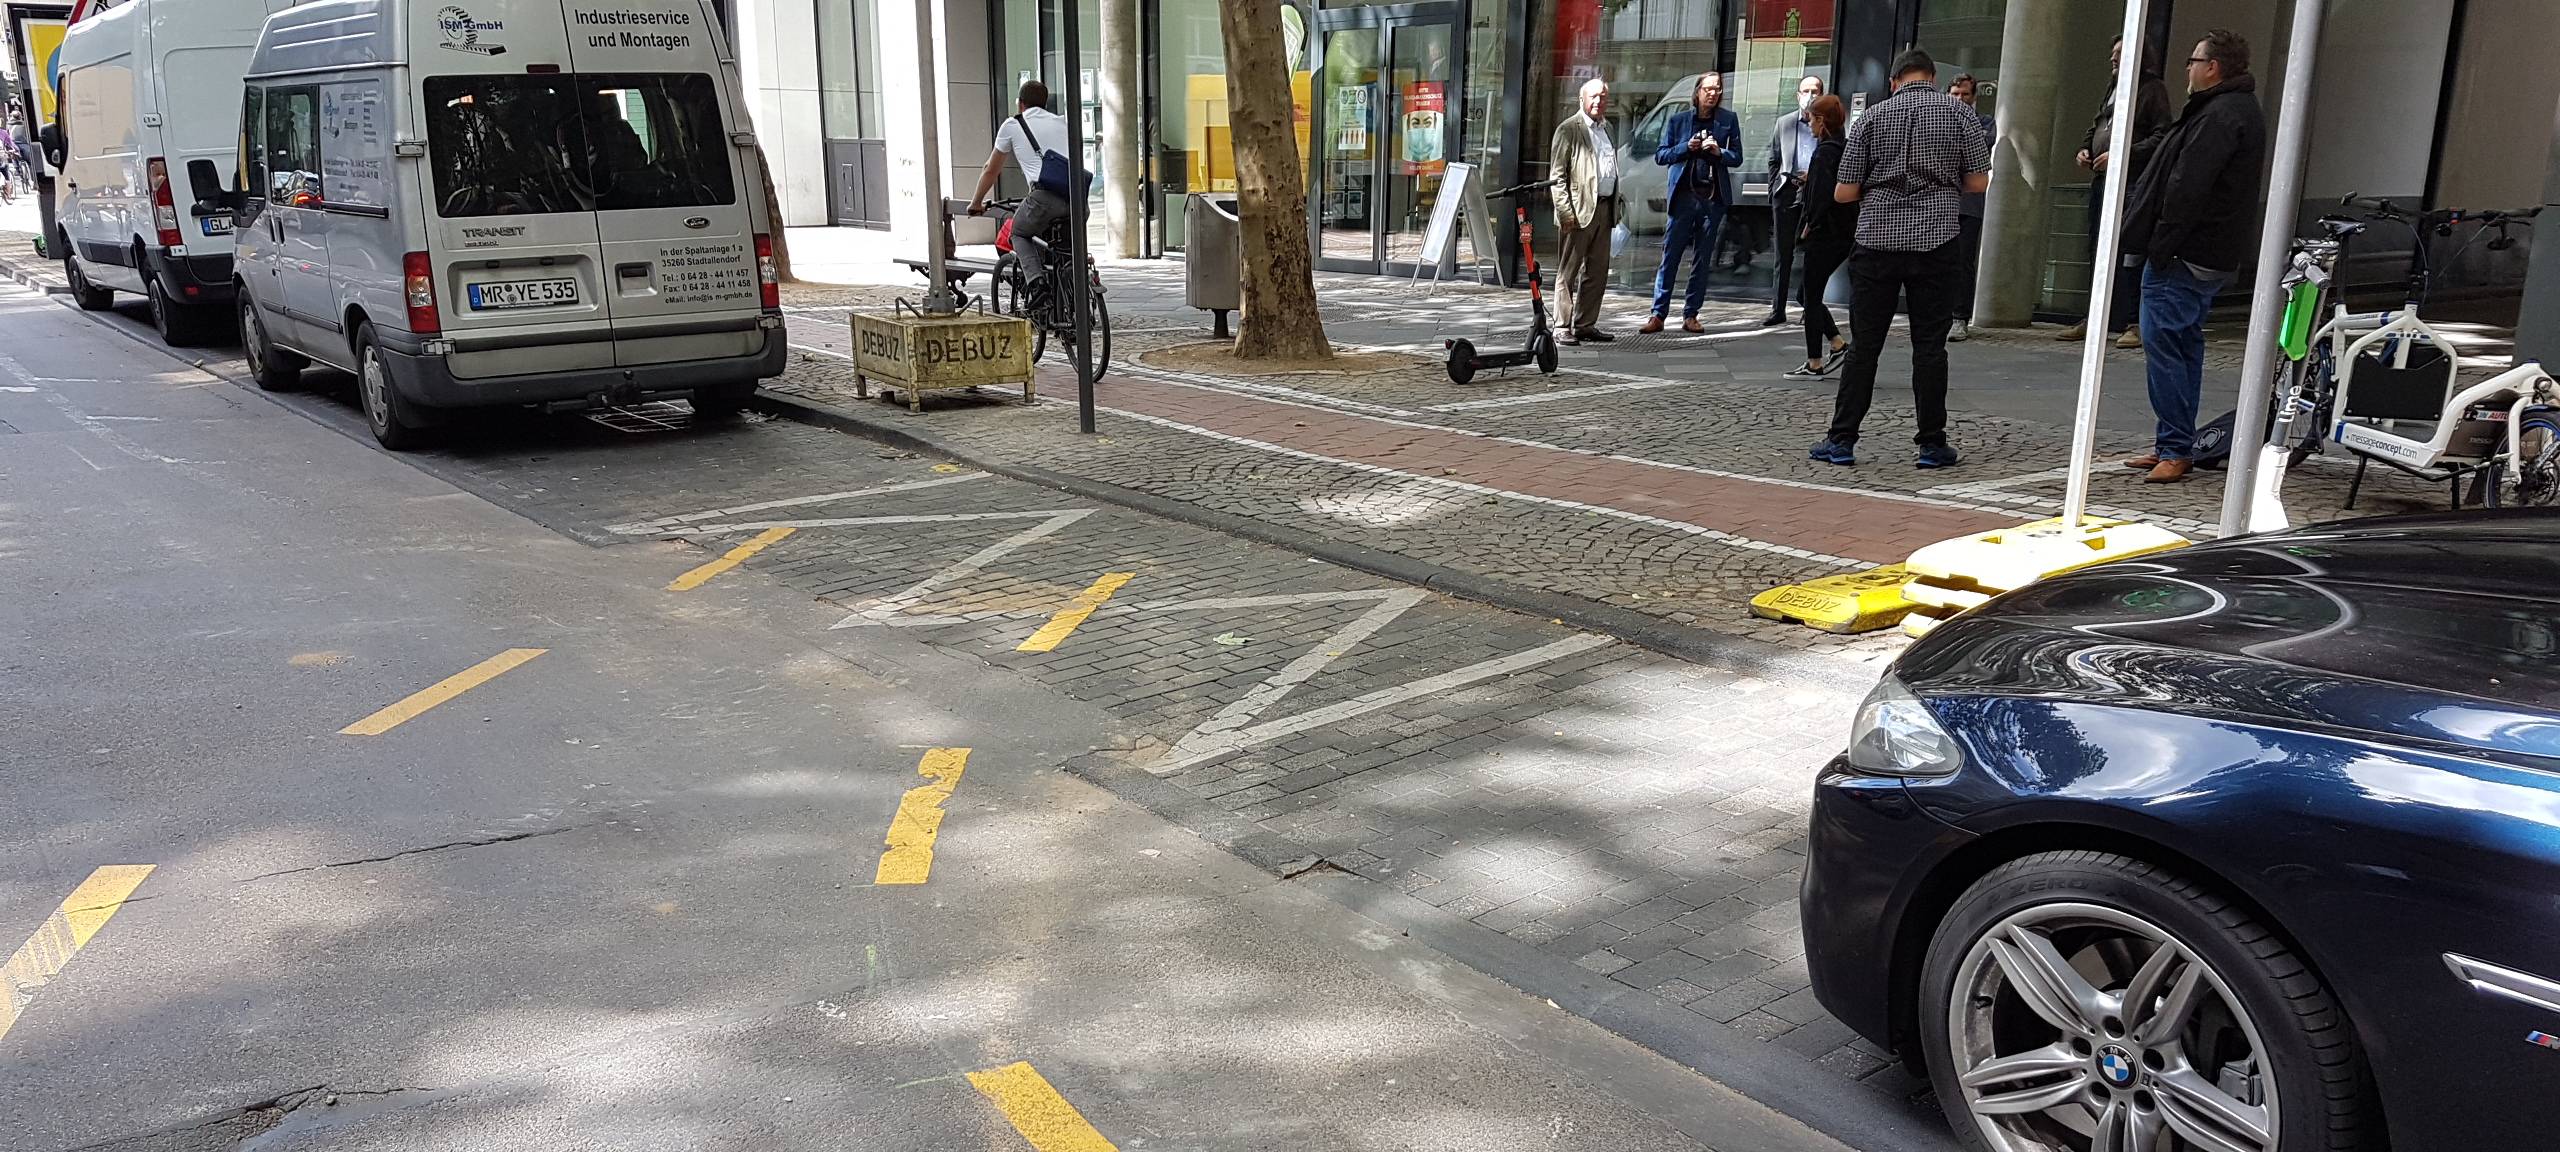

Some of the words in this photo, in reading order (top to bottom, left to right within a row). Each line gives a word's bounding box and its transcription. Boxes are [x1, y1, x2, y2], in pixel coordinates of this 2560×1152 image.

[467, 20, 504, 30] GmbH
[575, 9, 690, 24] Industrieservice
[588, 32, 617, 47] und
[620, 32, 690, 51] Montagen
[462, 226, 526, 238] TRANSIT
[670, 248, 683, 256] der
[685, 245, 730, 256] Spaltanlage
[662, 258, 685, 267] 35260
[687, 255, 741, 266] Stadtallendorf
[480, 285, 505, 304] MR
[515, 283, 540, 301] YE
[542, 281, 575, 300] 535
[862, 329, 900, 362] DEBUZ
[926, 335, 1013, 364] DEBUZ
[2278, 385, 2302, 423] Lime
[2350, 433, 2418, 460] messageconcept.com
[1775, 592, 1841, 613] DEBUZ
[2097, 1046, 2133, 1064] BMW
